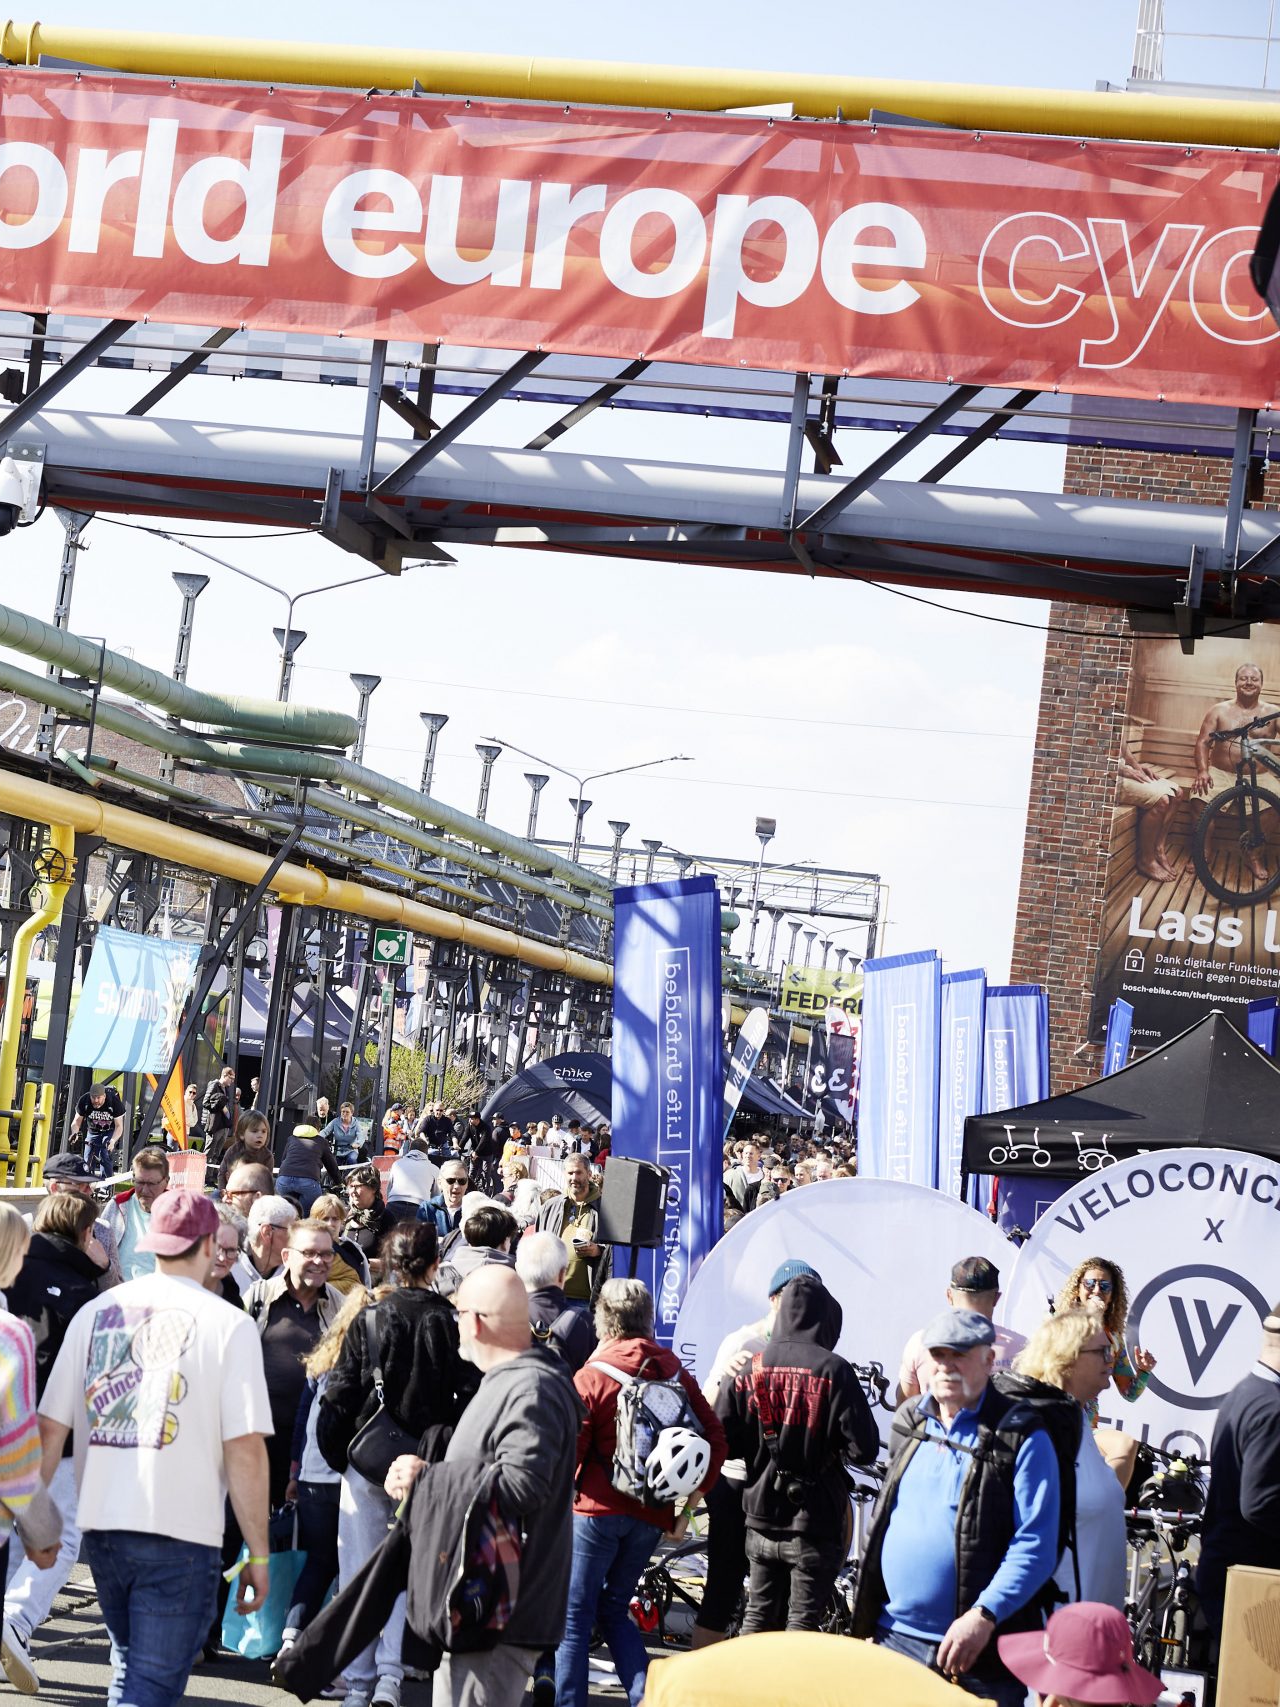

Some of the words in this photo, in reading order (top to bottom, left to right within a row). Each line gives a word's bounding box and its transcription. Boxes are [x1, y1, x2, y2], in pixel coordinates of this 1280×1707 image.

[321, 168, 928, 339] europe
[1128, 896, 1244, 948] Lass
[1153, 966, 1203, 980] zusätzlich
[1206, 973, 1236, 984] gegen
[1155, 954, 1181, 966] Dank
[1184, 956, 1227, 971] digitaler
[732, 1020, 764, 1090] VICTORIA
[1129, 1026, 1162, 1038] Systems
[553, 1066, 593, 1079] chike
[1054, 1161, 1280, 1234] VELOCONC
[93, 1367, 144, 1414] prince
